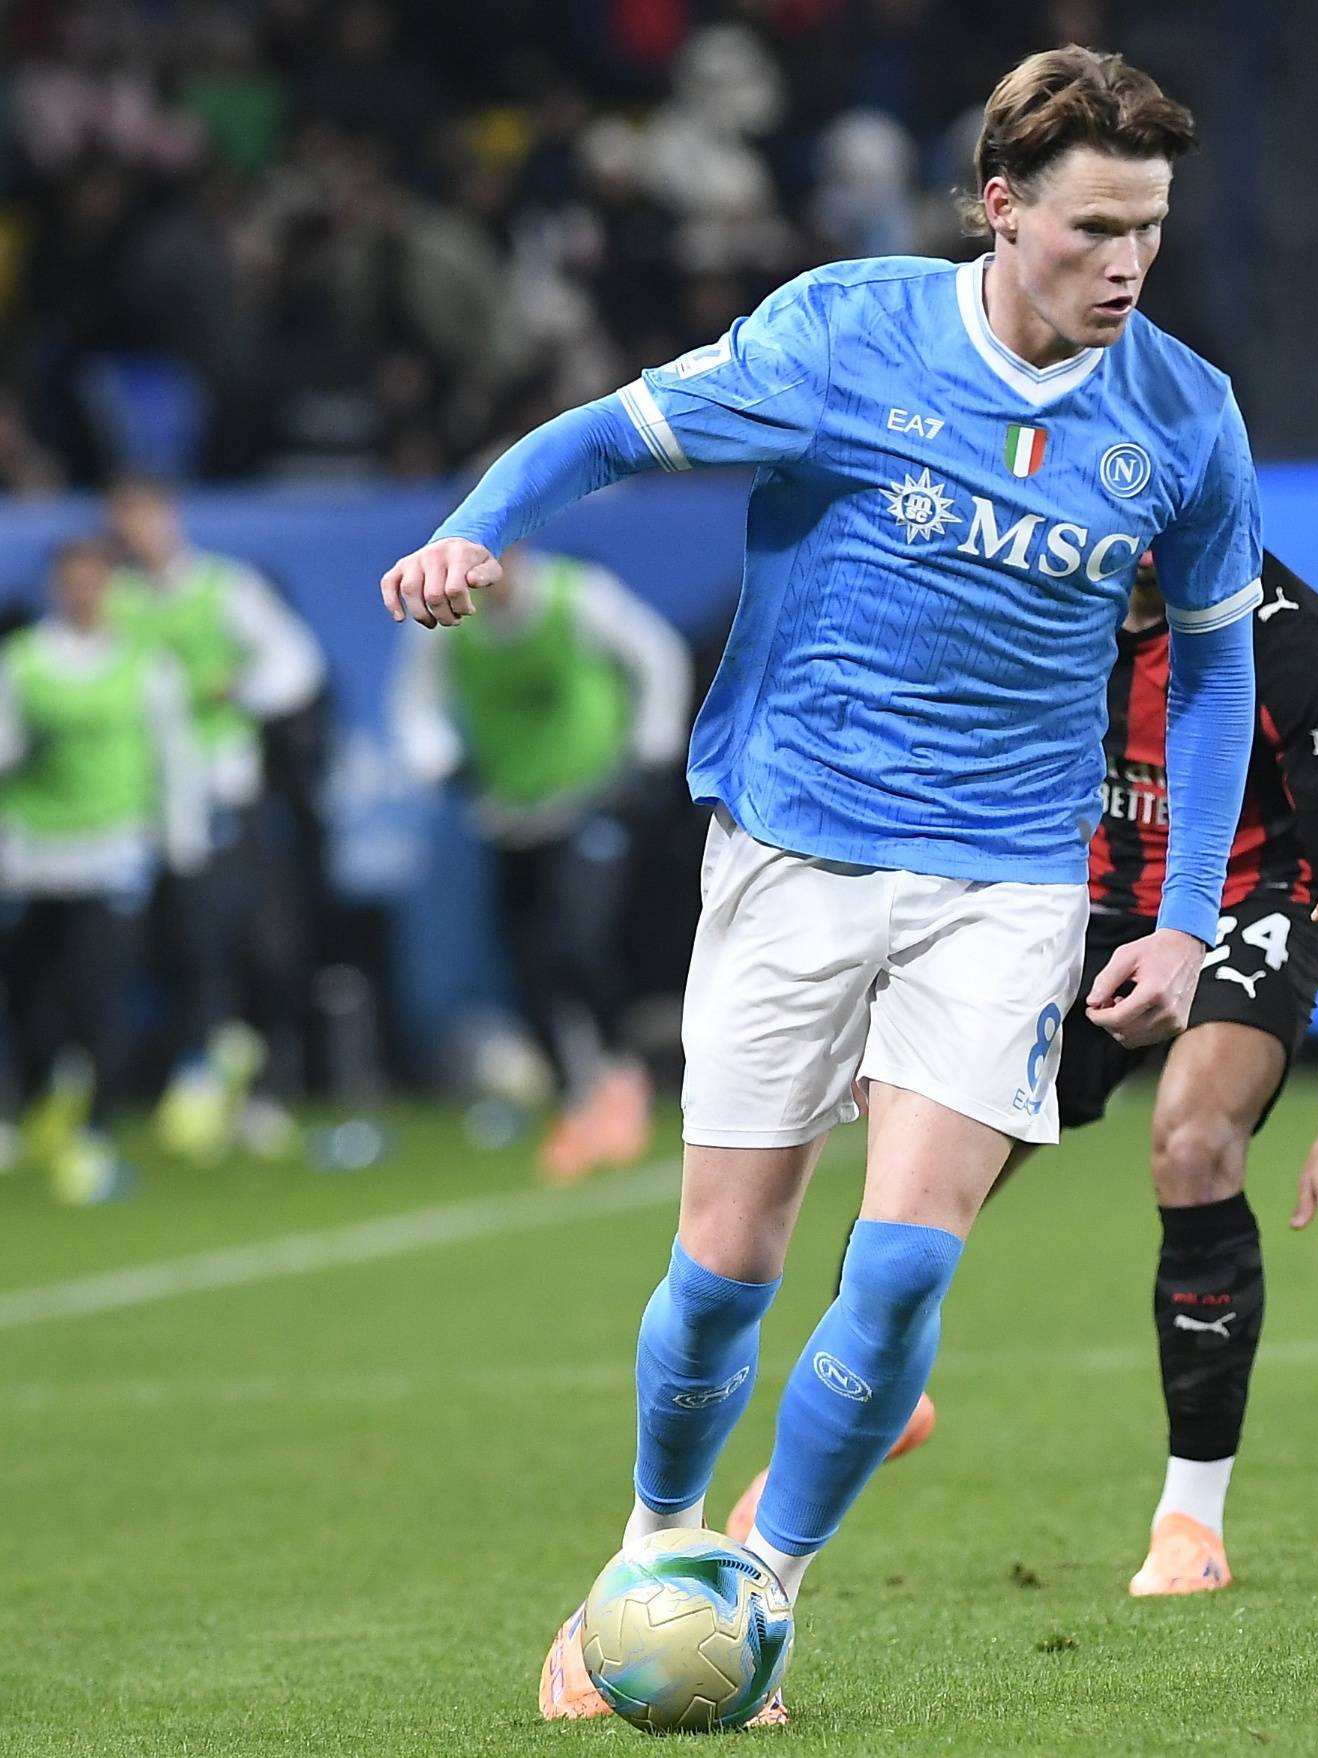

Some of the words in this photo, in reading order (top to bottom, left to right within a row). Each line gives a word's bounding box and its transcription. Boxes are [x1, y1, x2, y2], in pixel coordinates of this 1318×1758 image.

[887, 408, 944, 440] EA7
[1112, 457, 1137, 483] N
[957, 495, 1140, 582] MSC
